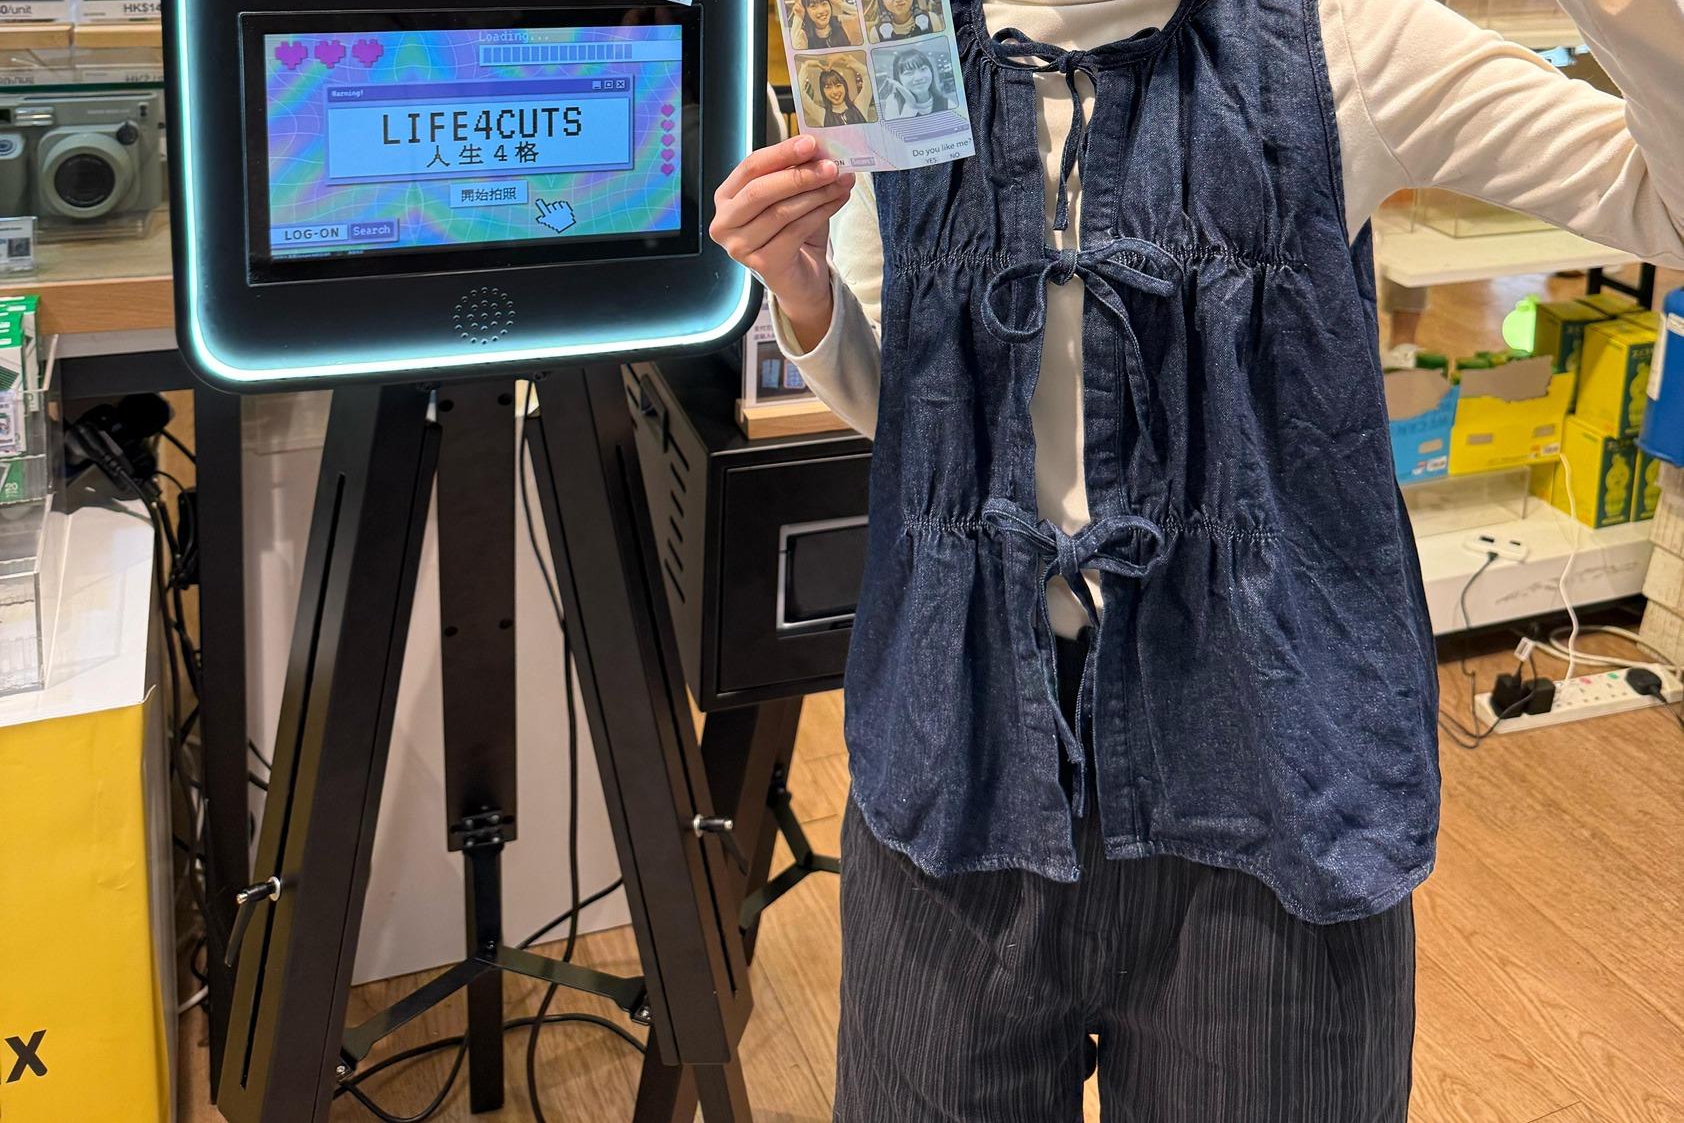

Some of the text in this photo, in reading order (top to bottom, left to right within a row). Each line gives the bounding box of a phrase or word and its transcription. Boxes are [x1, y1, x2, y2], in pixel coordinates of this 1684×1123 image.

[480, 30, 549, 43] Loading...
[382, 107, 582, 145] LIFE4CUTS
[912, 149, 925, 157] Do
[926, 146, 940, 156] you
[941, 142, 955, 151] like
[460, 186, 517, 202] 開始拍照
[284, 224, 391, 241] LOG-ON Search
